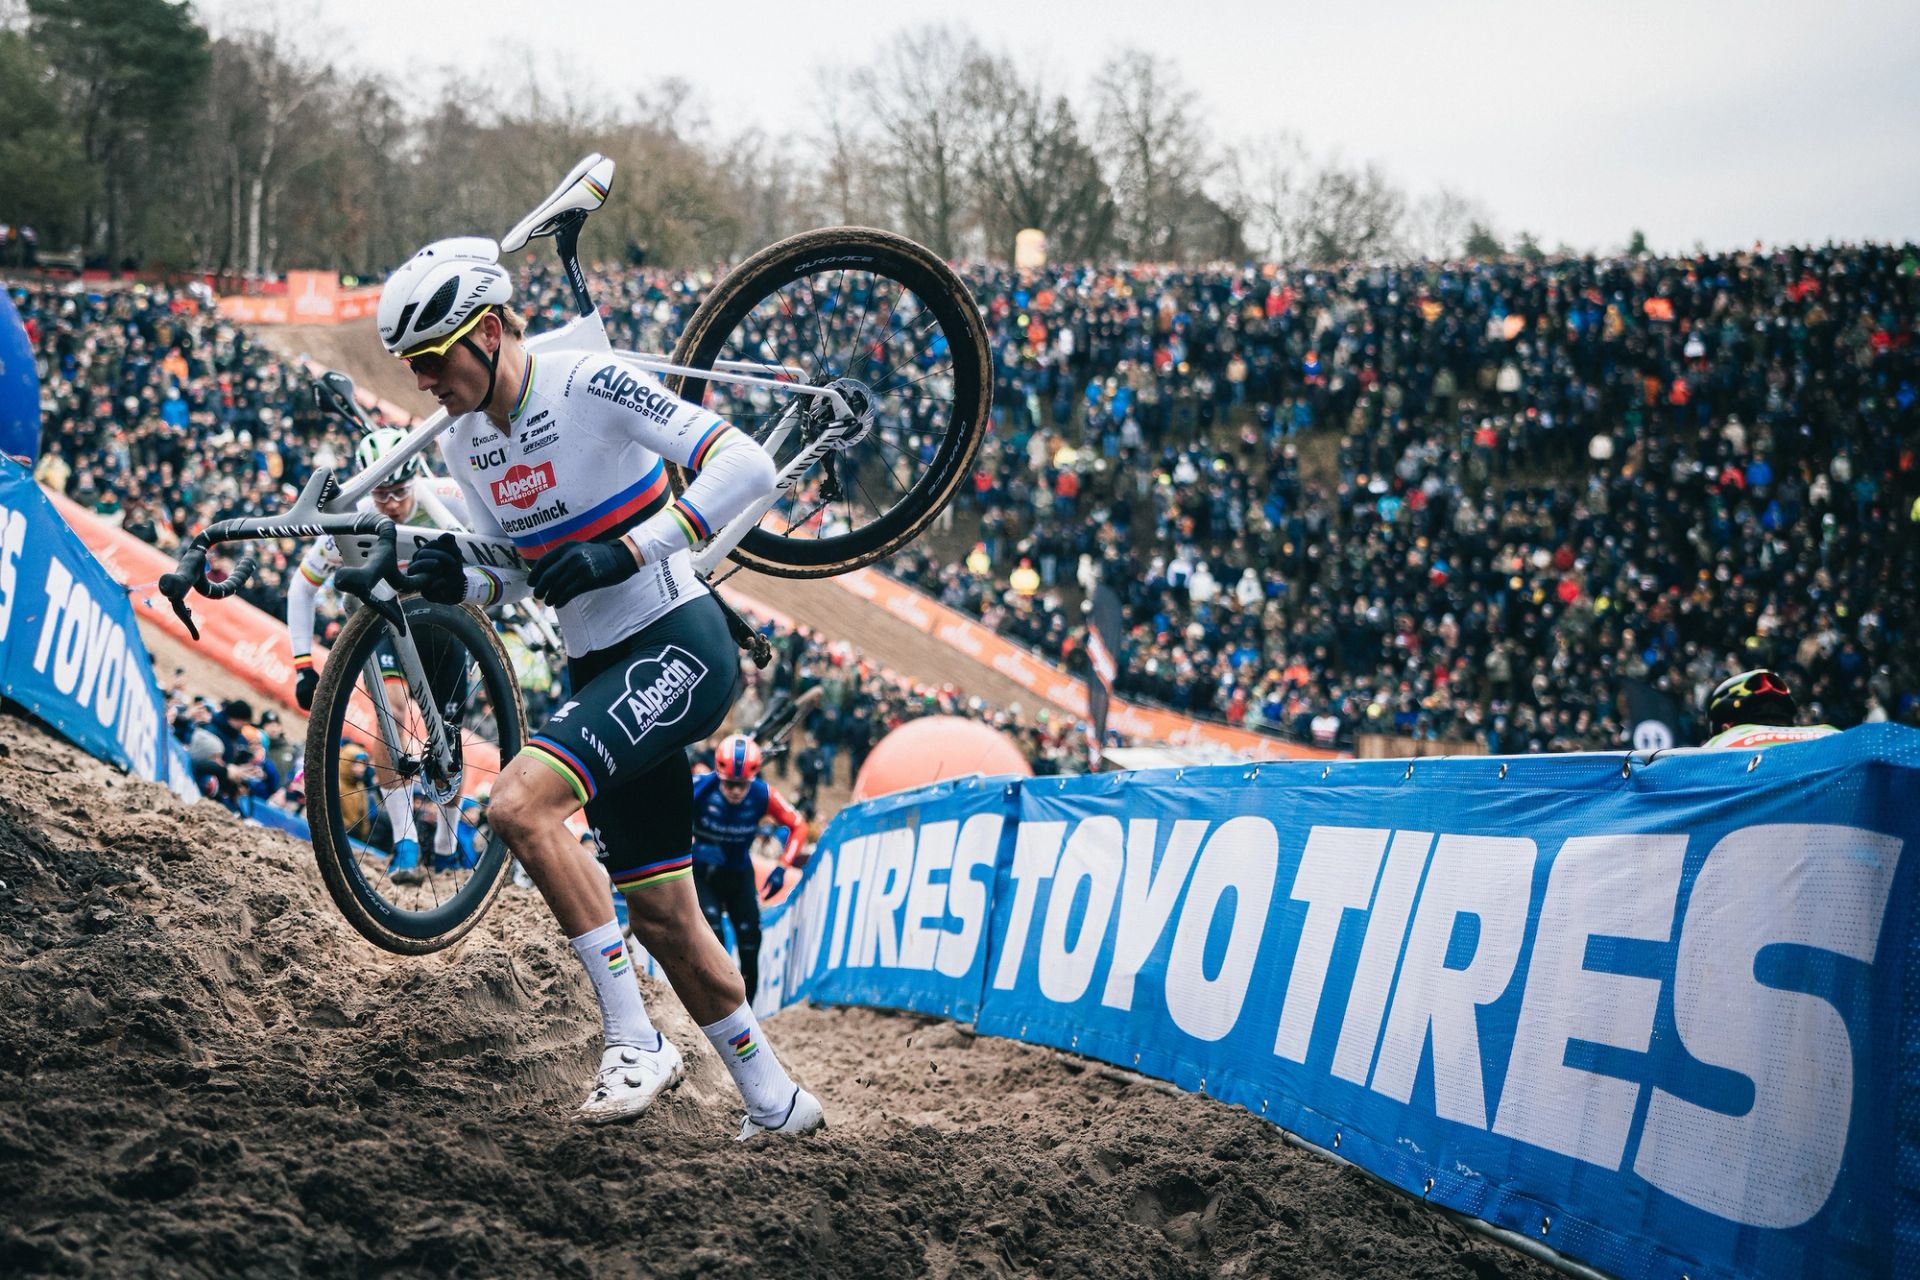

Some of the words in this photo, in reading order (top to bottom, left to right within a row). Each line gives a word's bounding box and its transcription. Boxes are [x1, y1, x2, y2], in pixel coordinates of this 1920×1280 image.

[570, 256, 585, 293] CANYON
[445, 276, 495, 326] CANYON
[586, 384, 613, 400] HAIR
[618, 397, 669, 427] BOOSTER
[590, 364, 679, 419] Alpecin
[531, 420, 556, 437] ZWIFT
[476, 448, 507, 470] UCI
[776, 434, 843, 490] CANYON
[318, 474, 336, 508] CANYON
[499, 469, 548, 499] Alpecin
[257, 524, 328, 537] CANYON
[501, 499, 569, 533] deceuninck
[33, 556, 126, 728] TOYO
[627, 658, 693, 726] Alpecin
[639, 711, 660, 732] HAIR
[661, 672, 698, 710] BOOSTER
[581, 726, 617, 777] CANYON
[827, 812, 1005, 979] TIRES
[992, 815, 1280, 1042] TOYO
[1272, 822, 1904, 1231] TIRES
